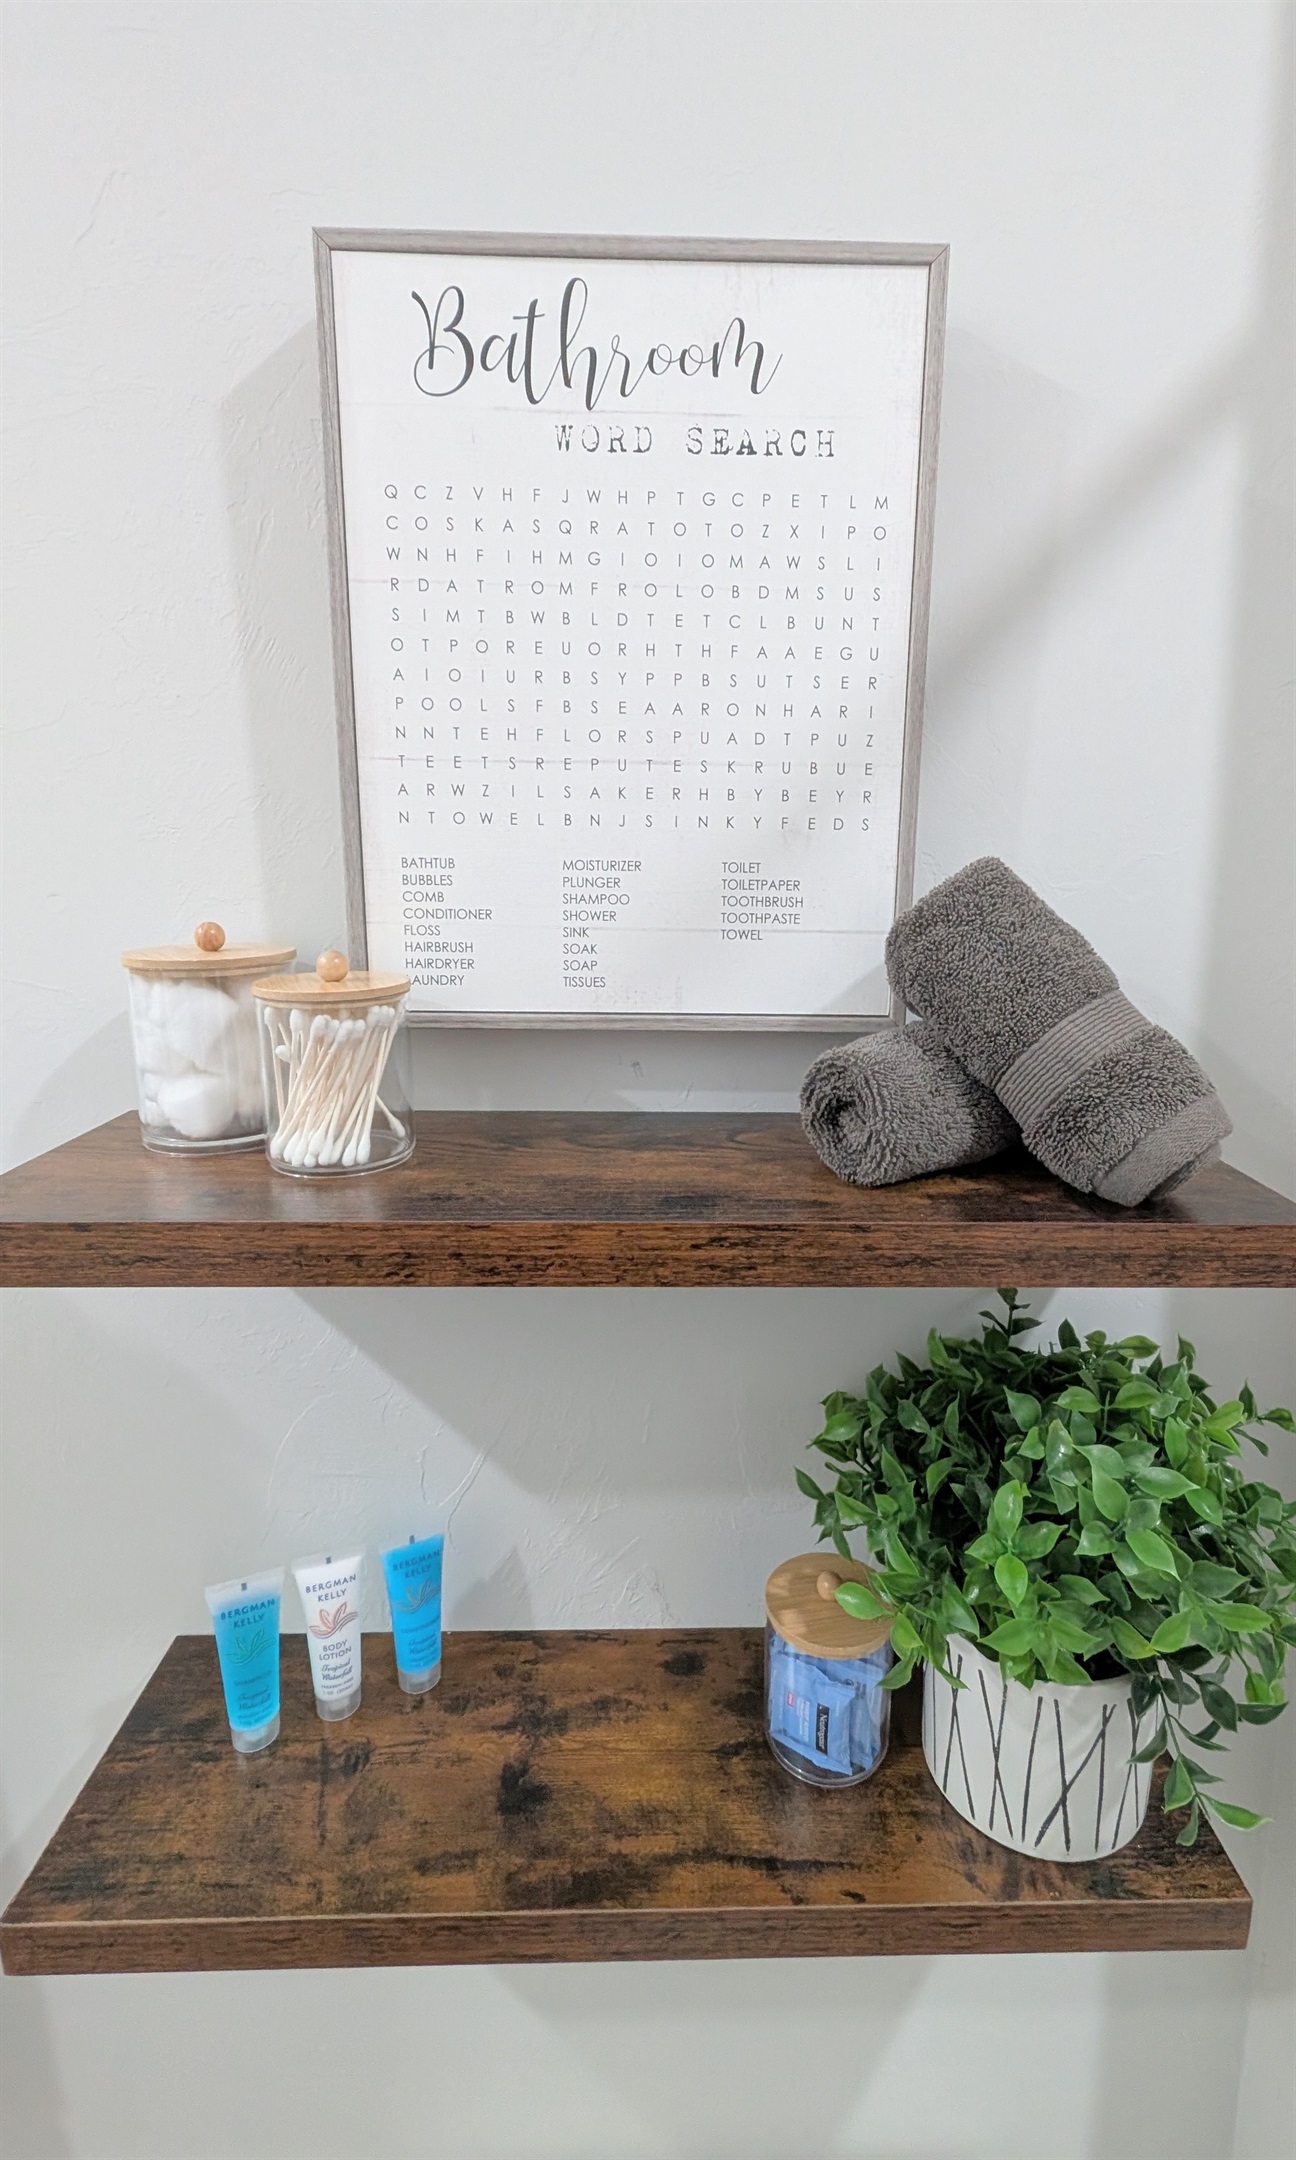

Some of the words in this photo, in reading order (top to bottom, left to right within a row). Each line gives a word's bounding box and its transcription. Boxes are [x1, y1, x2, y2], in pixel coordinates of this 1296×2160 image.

[411, 277, 783, 412] Bathroom
[555, 425, 653, 454] WORD
[686, 426, 836, 458] SEARCH
[401, 856, 456, 870] BATHTUB
[562, 859, 642, 872] MOISTURIZER
[721, 861, 762, 874] TOILET
[401, 873, 454, 887] BUBBLES
[562, 876, 621, 889] PLUNGER
[721, 878, 801, 892] TOILETPAPER
[402, 890, 445, 903] COMB
[562, 892, 631, 906] SHAMPOO
[720, 895, 804, 908] TOOTHBRUSH
[402, 907, 493, 921] CONDITIONER
[562, 909, 617, 922] SHOWER
[720, 912, 801, 925] TOOTHPASTE
[403, 924, 441, 937] FLOSS
[562, 926, 590, 938] SINK
[720, 928, 764, 941] TOWEL
[404, 941, 474, 954] HAIRBRUSH
[562, 942, 598, 955] SOAK
[405, 957, 475, 970] HAIRDRYER
[562, 959, 598, 972] SOAP
[407, 974, 465, 986] AUNDRY
[562, 976, 607, 988] TISSUES
[393, 1549, 440, 1571] BERGMAN
[305, 1574, 356, 1593] BERGMAN
[318, 1588, 346, 1602] KELLY
[220, 1599, 275, 1620] BERGMAN
[234, 1614, 264, 1629] KELLY
[323, 1640, 347, 1652] BODY
[319, 1646, 351, 1661] LOTION
